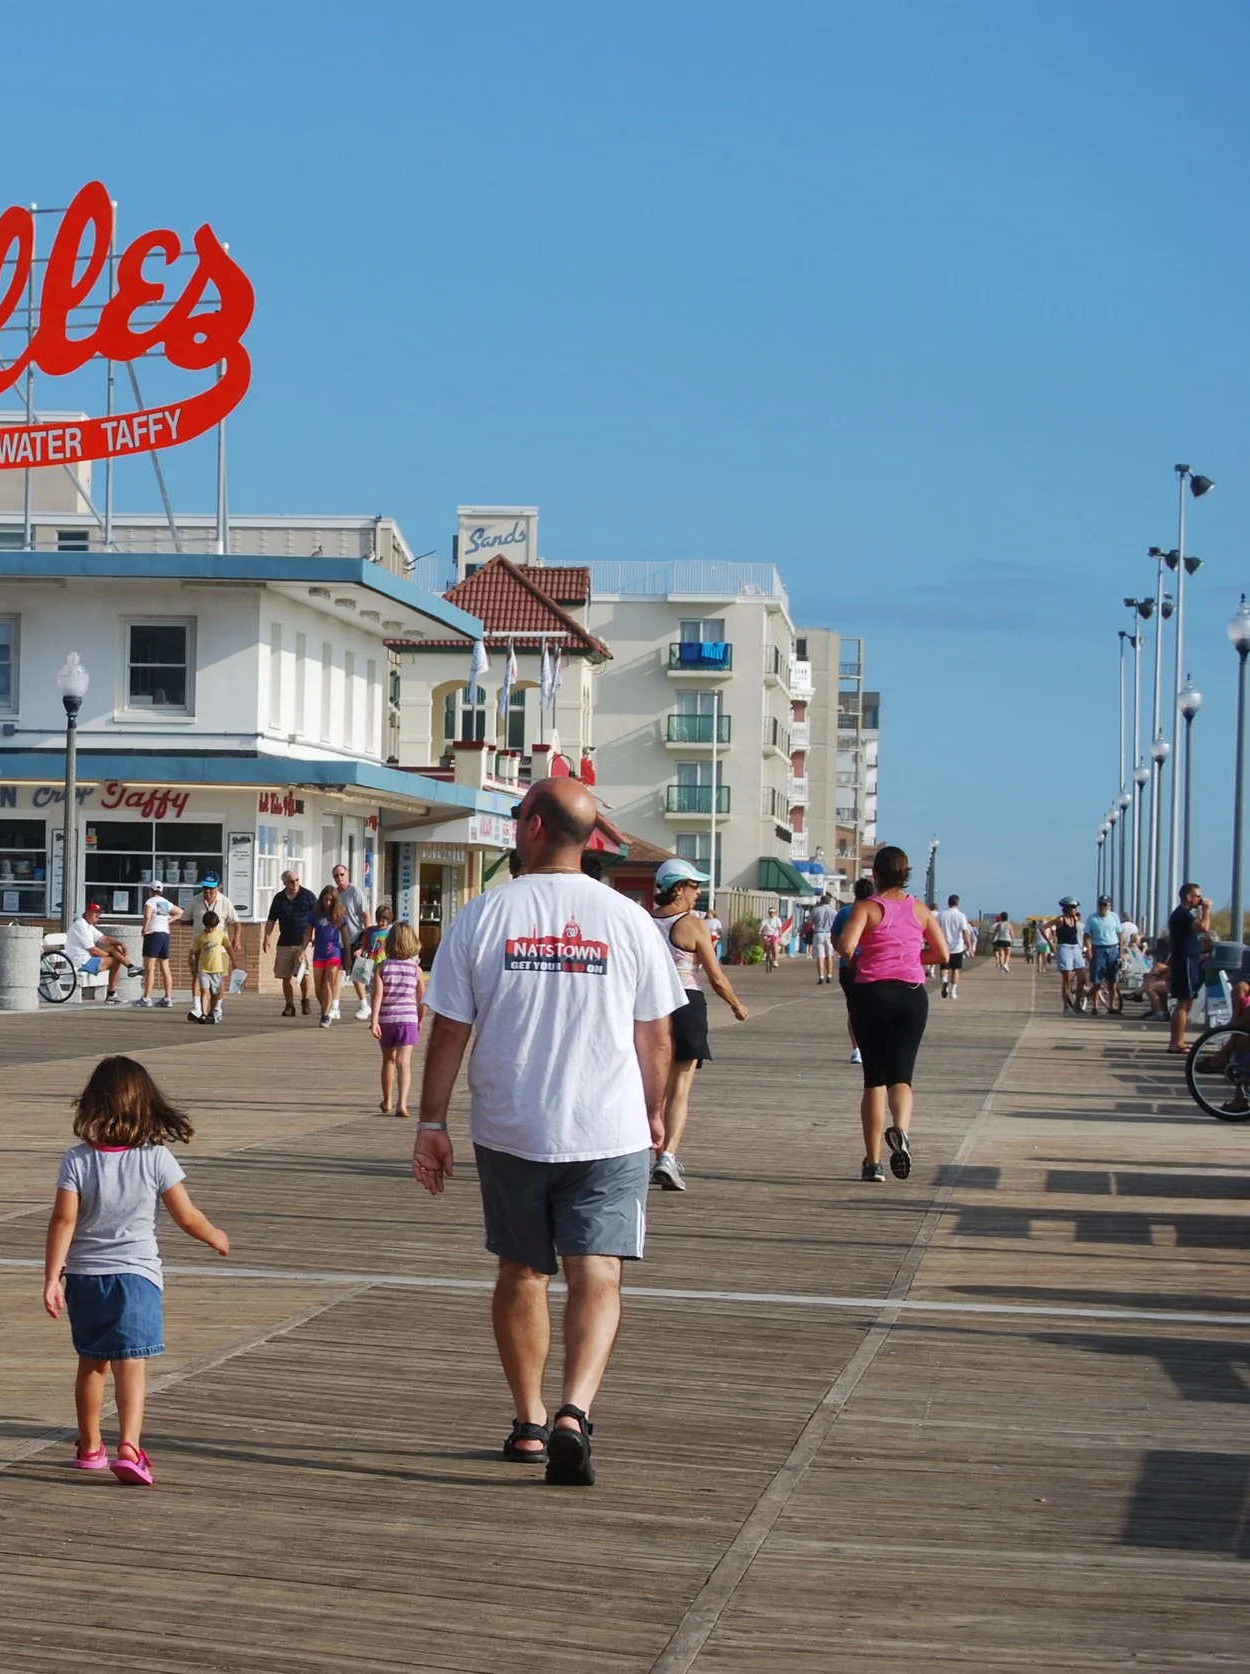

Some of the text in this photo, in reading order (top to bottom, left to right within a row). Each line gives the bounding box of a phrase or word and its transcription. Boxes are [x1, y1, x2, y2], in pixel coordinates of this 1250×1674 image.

[101, 408, 182, 452] TAFFY
[465, 521, 527, 555] Sands
[101, 782, 190, 820] Taffy
[510, 961, 532, 970] GET
[533, 961, 562, 971] YOUR
[586, 964, 603, 974] ON
